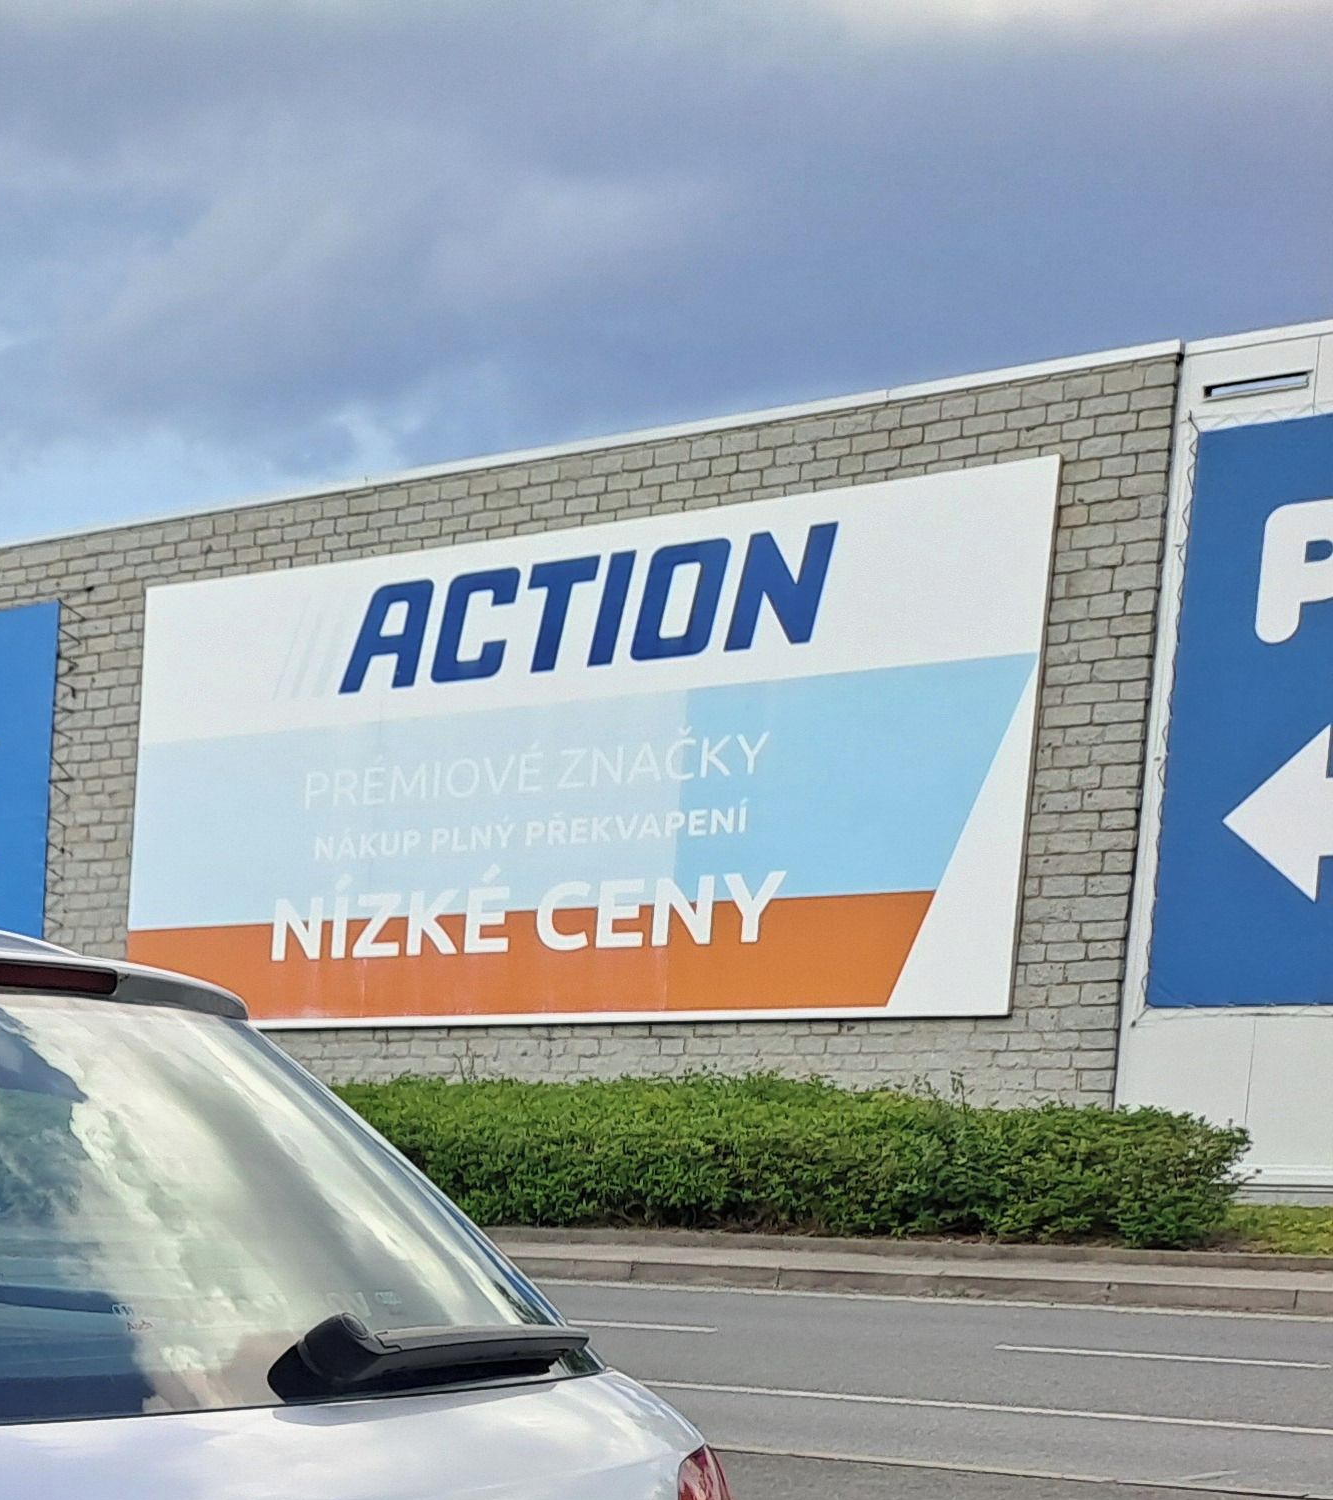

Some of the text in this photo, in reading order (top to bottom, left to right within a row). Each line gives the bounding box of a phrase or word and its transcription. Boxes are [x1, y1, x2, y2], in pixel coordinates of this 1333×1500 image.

[338, 521, 840, 695] ACTION
[304, 726, 770, 810] PRÉMIOVÉ ZNAČKY
[314, 798, 749, 861] NÁKUP PLNÝ PŘEKVAPENÍ
[271, 864, 788, 962] NÍZKÉ CENY
